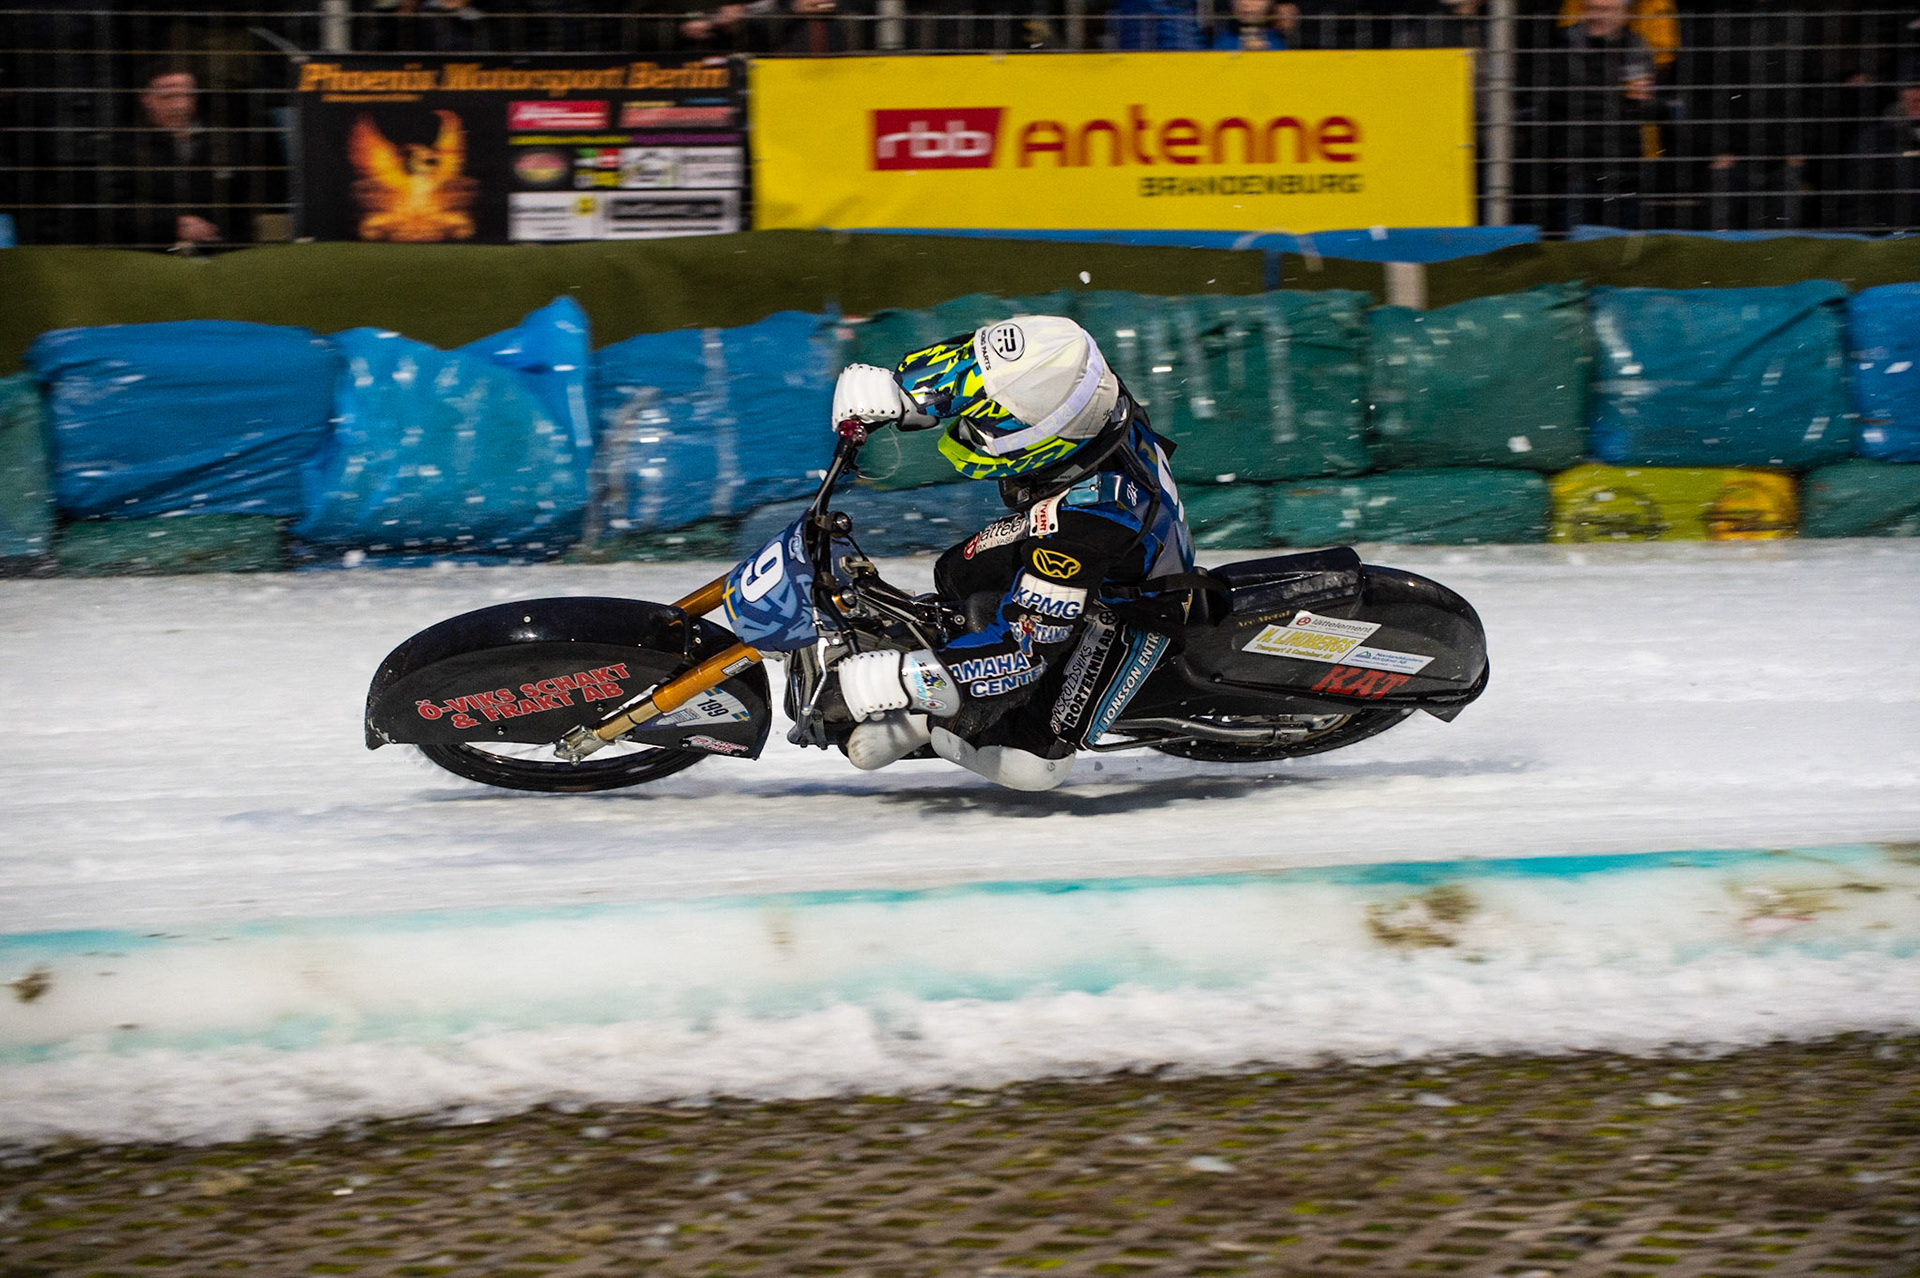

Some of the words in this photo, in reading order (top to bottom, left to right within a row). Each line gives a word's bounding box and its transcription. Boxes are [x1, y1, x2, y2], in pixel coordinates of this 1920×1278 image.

[627, 61, 731, 89] Berlin
[875, 119, 994, 159] rbb
[1016, 103, 1364, 168] Antenne
[1137, 173, 1364, 198] BRANDENBURG
[740, 540, 784, 603] 9
[1013, 587, 1081, 618] KPMG
[1274, 630, 1357, 654] LINDBERGS
[949, 652, 1031, 683] AMAHA
[415, 687, 516, 720] Ö-VIKS
[519, 662, 631, 698] SCHAKT
[451, 713, 482, 729] &
[480, 690, 575, 722] FRAKT
[581, 682, 625, 702] AB
[697, 698, 730, 718] 199
